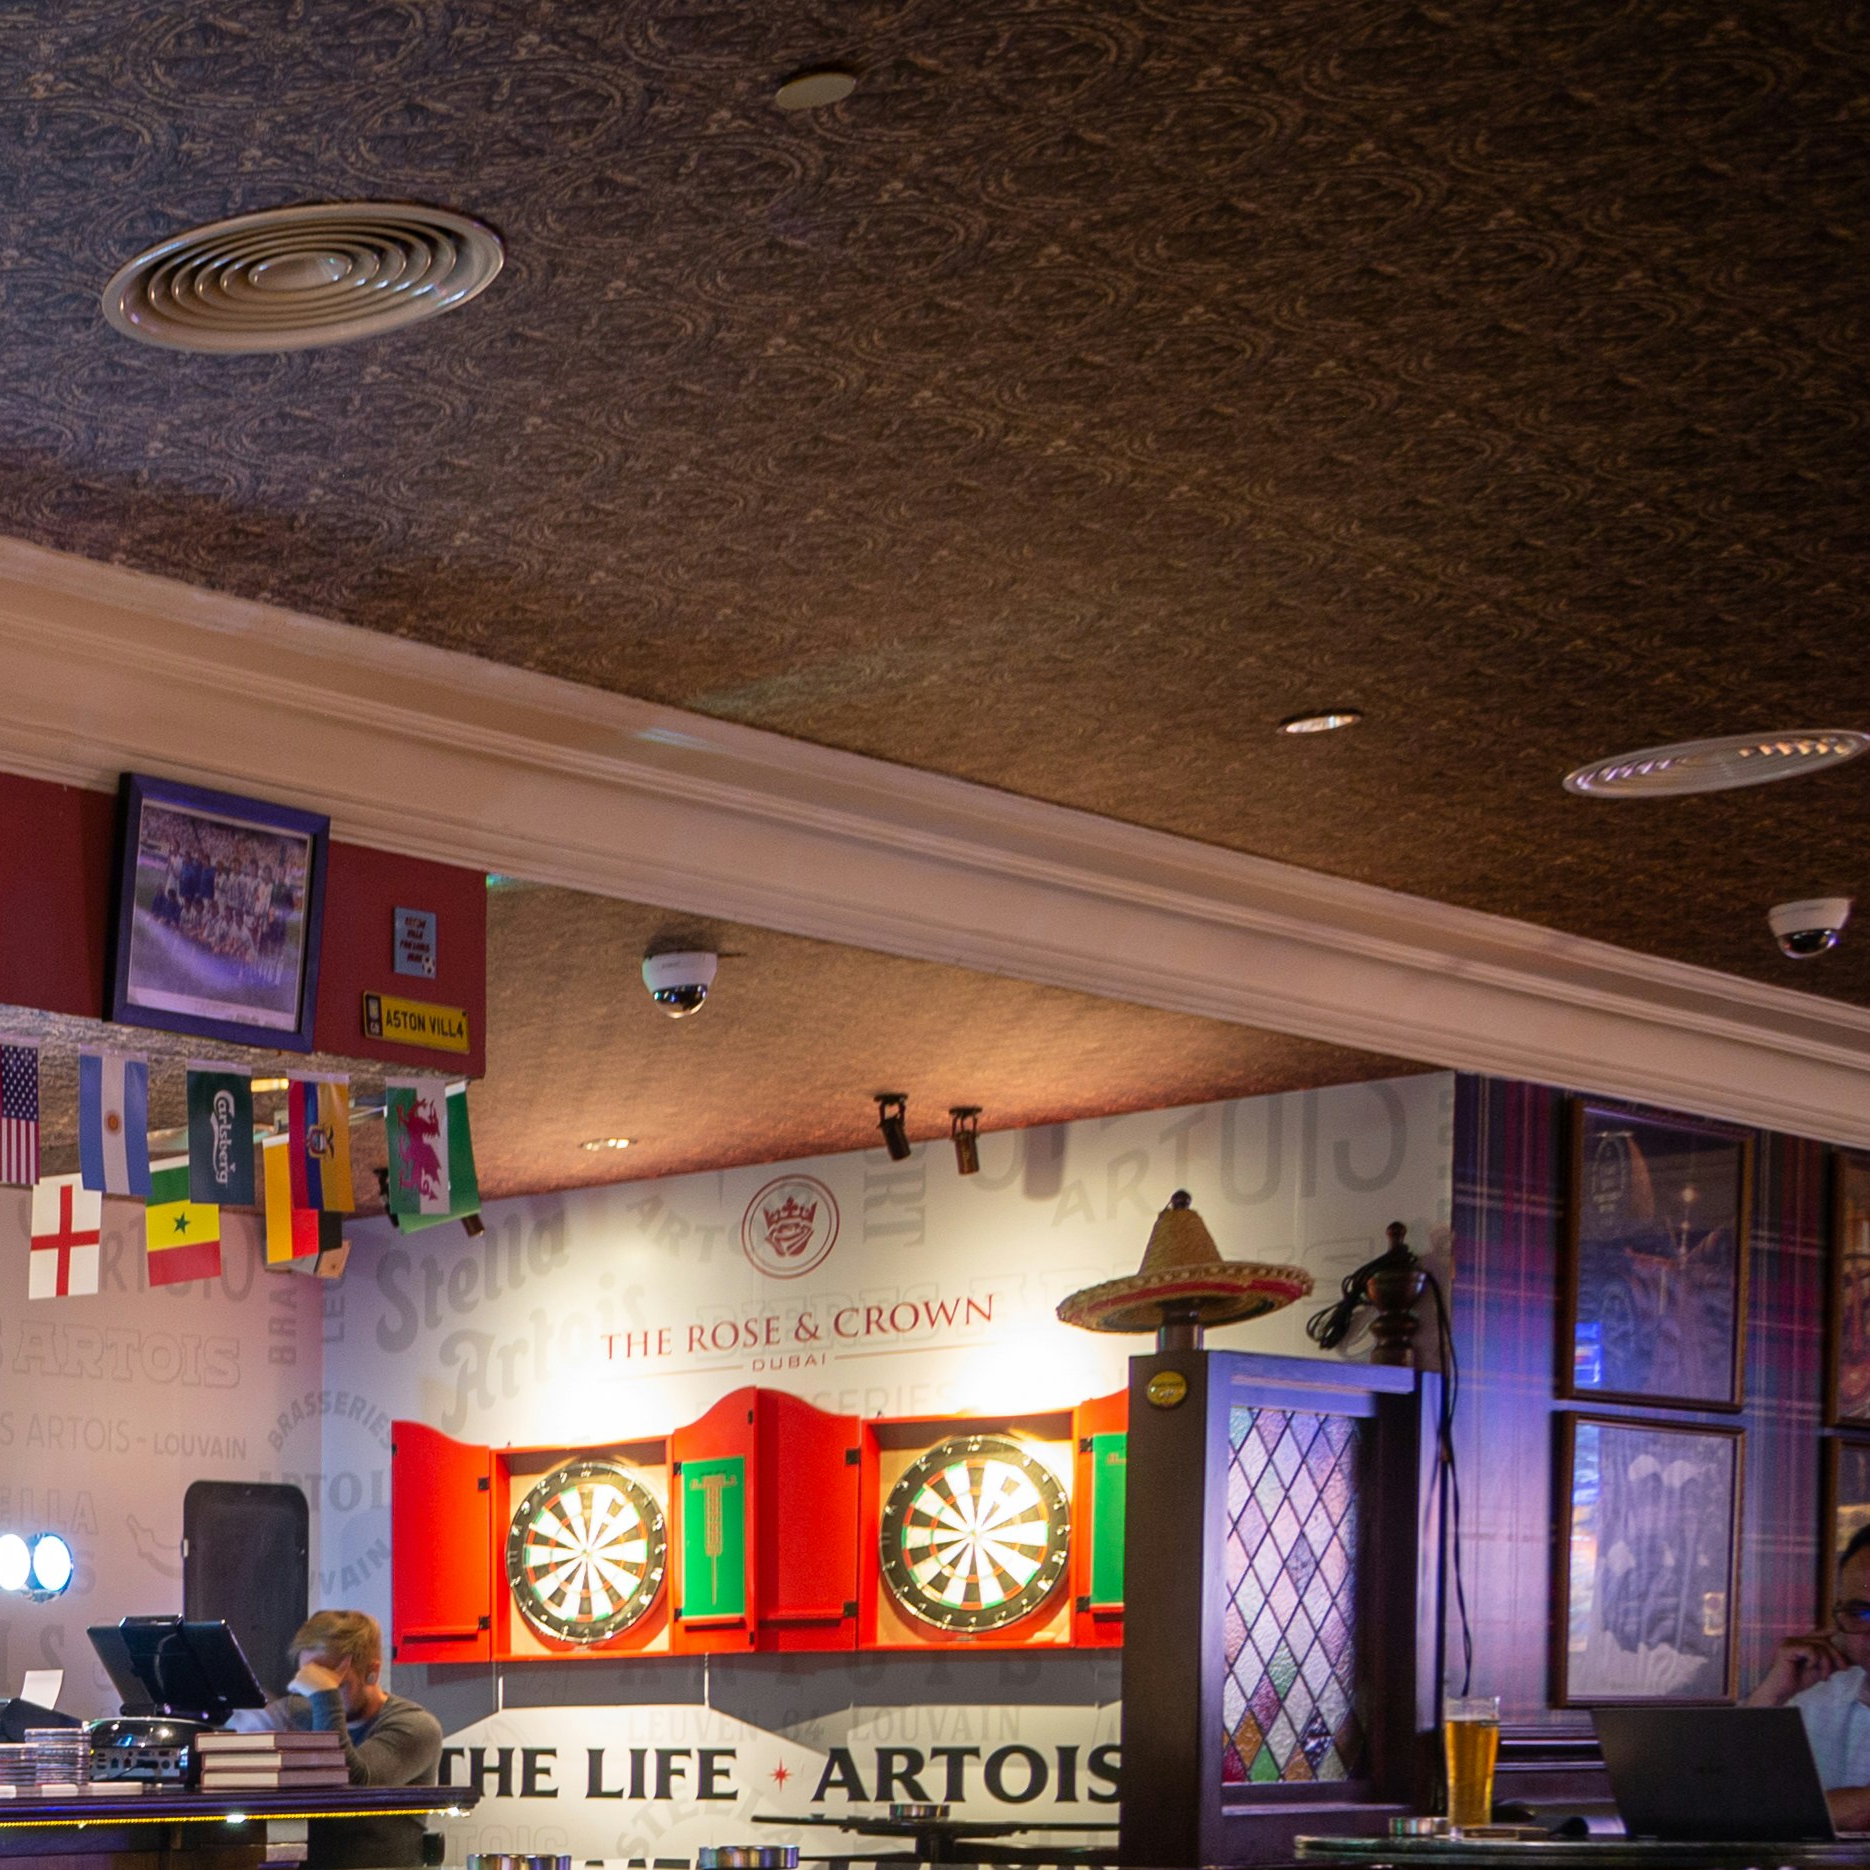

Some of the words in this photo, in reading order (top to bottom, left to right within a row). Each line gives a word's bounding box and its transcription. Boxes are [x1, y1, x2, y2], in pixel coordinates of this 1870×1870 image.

[386, 1009, 425, 1032] ASTON
[211, 1089, 235, 1185] Carlsberg
[375, 1207, 569, 1355] Stella
[13, 1320, 243, 1390] ARTOIS
[440, 1273, 647, 1432] Artois
[601, 1327, 673, 1360] THE
[687, 1314, 786, 1353] ROSE
[793, 1310, 825, 1340] &
[833, 1293, 995, 1342] CROWN
[752, 1352, 827, 1373] DUBAI
[26, 1414, 130, 1455] ARTOIS
[153, 1432, 247, 1460] LOUVAIN
[437, 1747, 559, 1800] THE
[585, 1747, 740, 1801] LIFE
[811, 1744, 1121, 1806] ARTOIS
